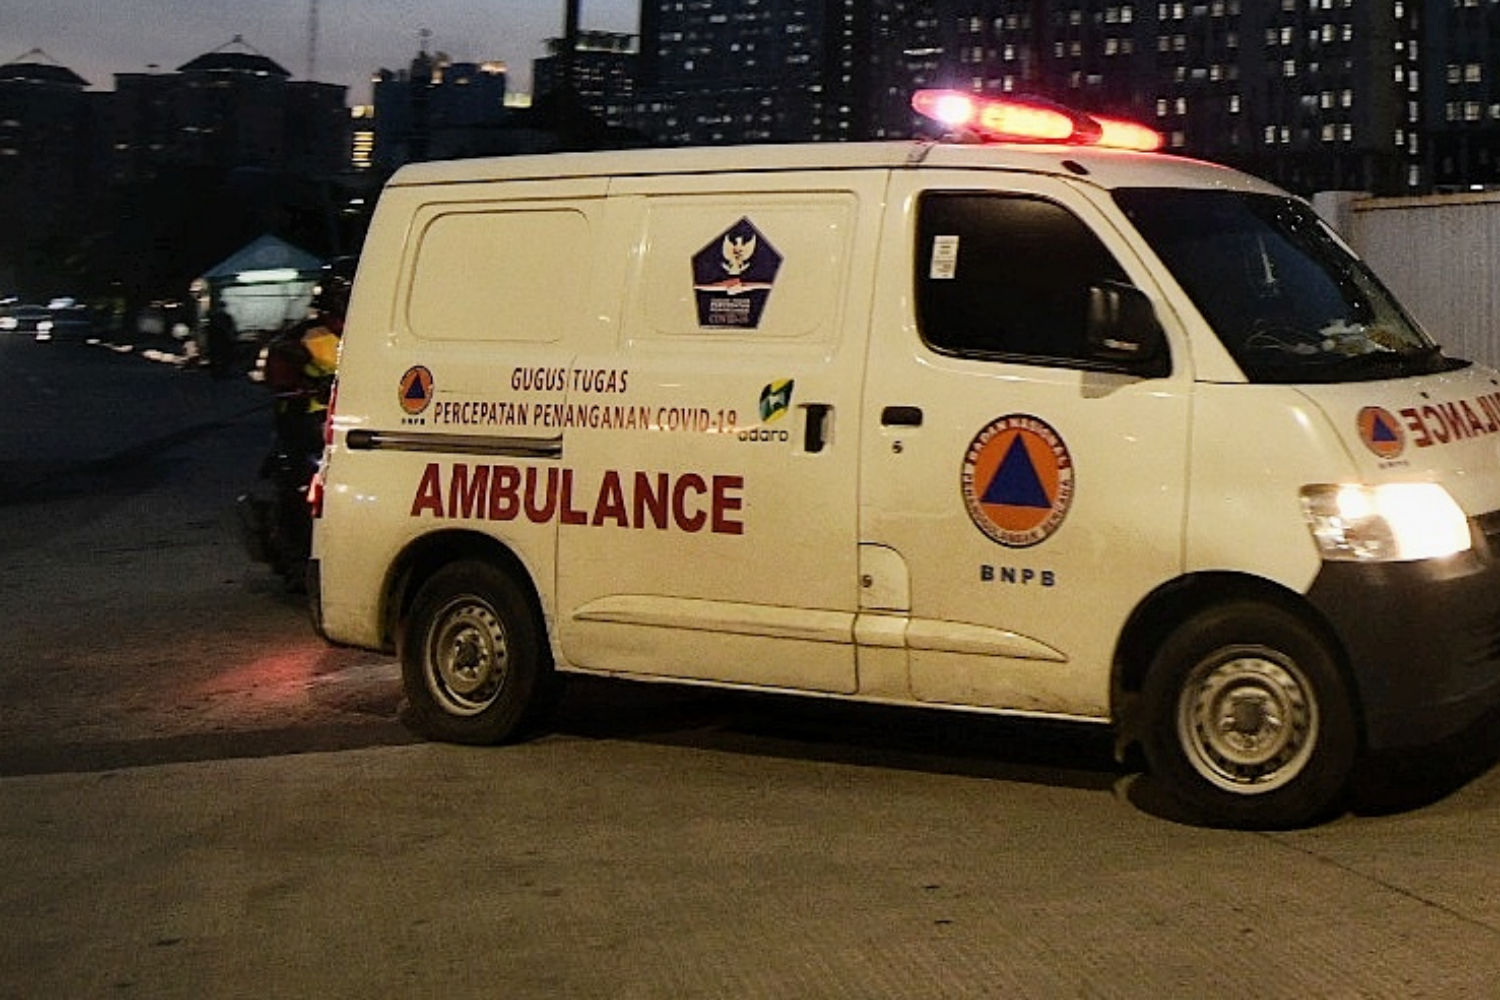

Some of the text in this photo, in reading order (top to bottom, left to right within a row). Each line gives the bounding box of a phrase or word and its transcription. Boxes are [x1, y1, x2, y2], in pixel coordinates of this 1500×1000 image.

[511, 367, 629, 393] GUGUS TUGAS
[434, 402, 737, 434] PERCEPATAN PENANGANAN COVID-19
[410, 463, 744, 535] AMBULANCE
[980, 565, 1055, 587] BNPB
